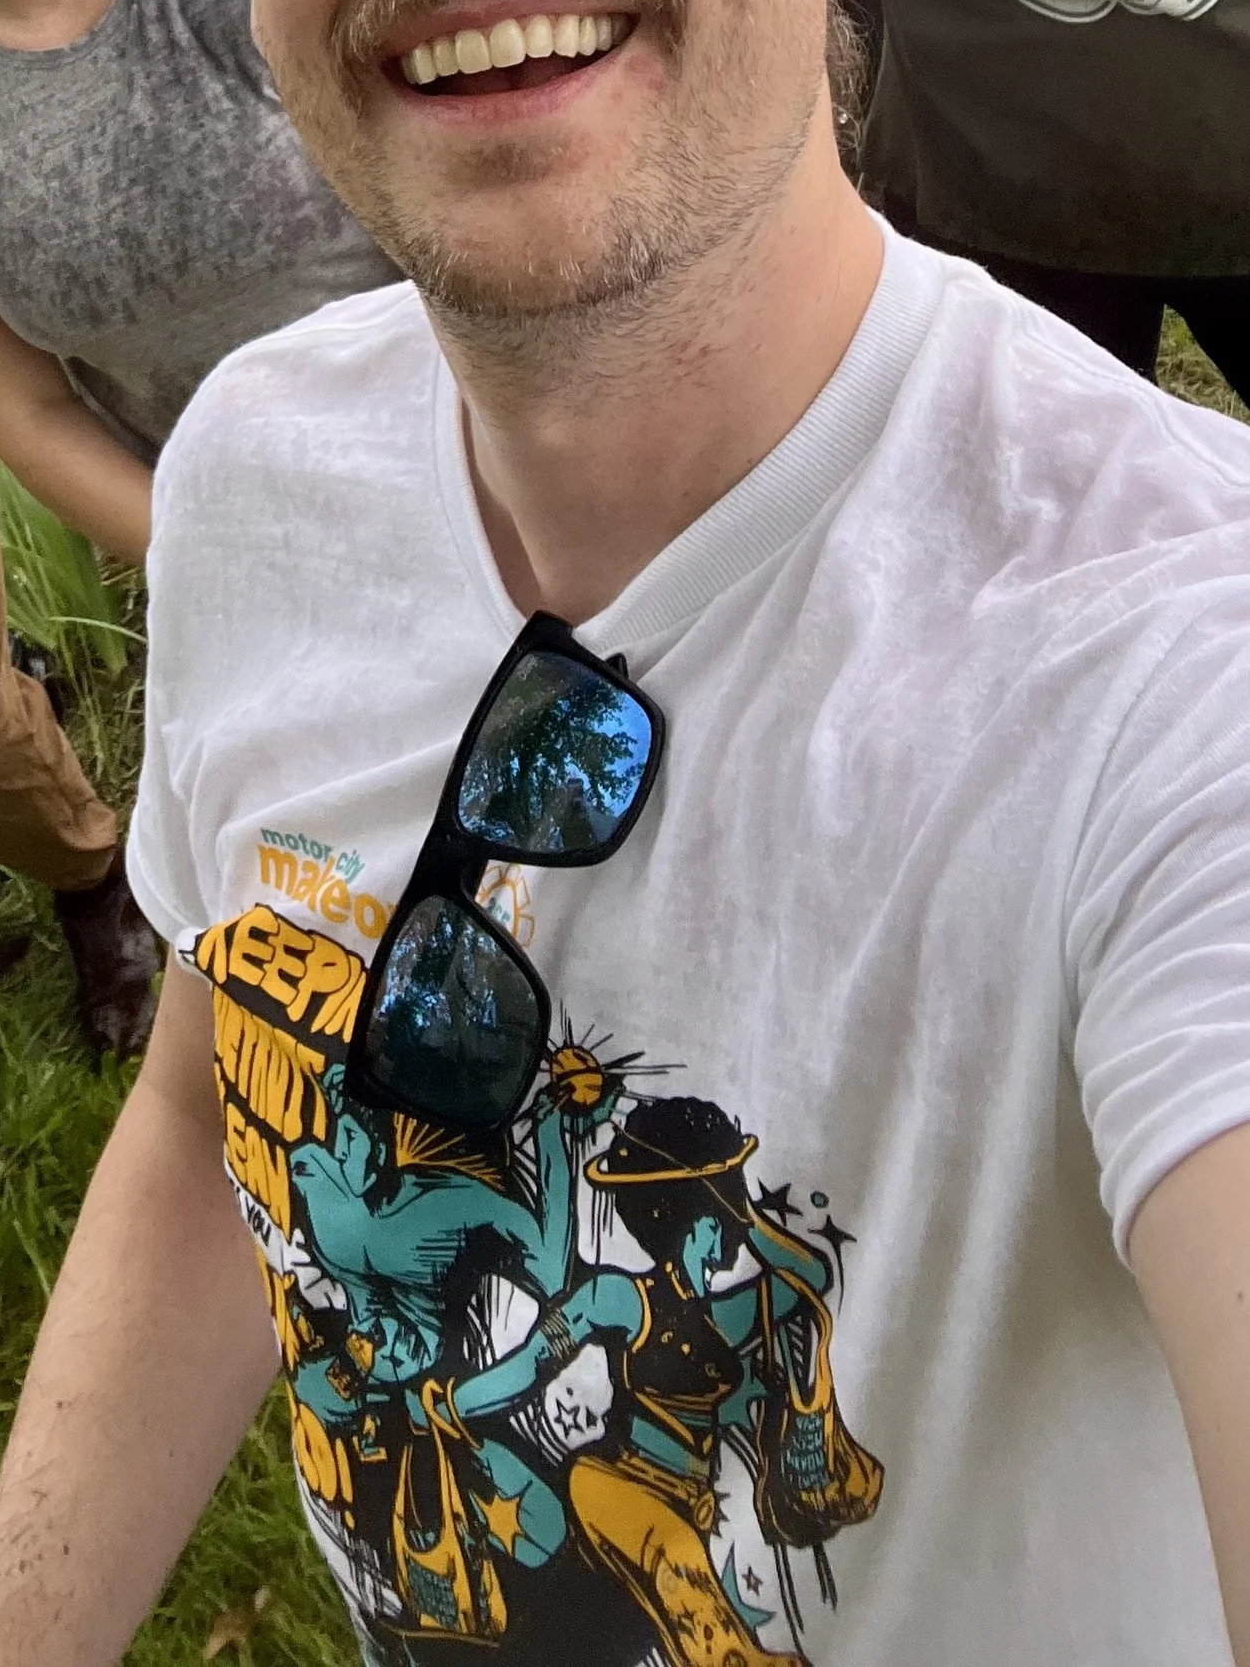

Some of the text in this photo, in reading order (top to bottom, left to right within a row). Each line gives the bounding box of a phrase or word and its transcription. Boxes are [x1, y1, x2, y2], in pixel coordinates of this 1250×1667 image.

[257, 844, 396, 939] makeo
[260, 827, 365, 885] motor city
